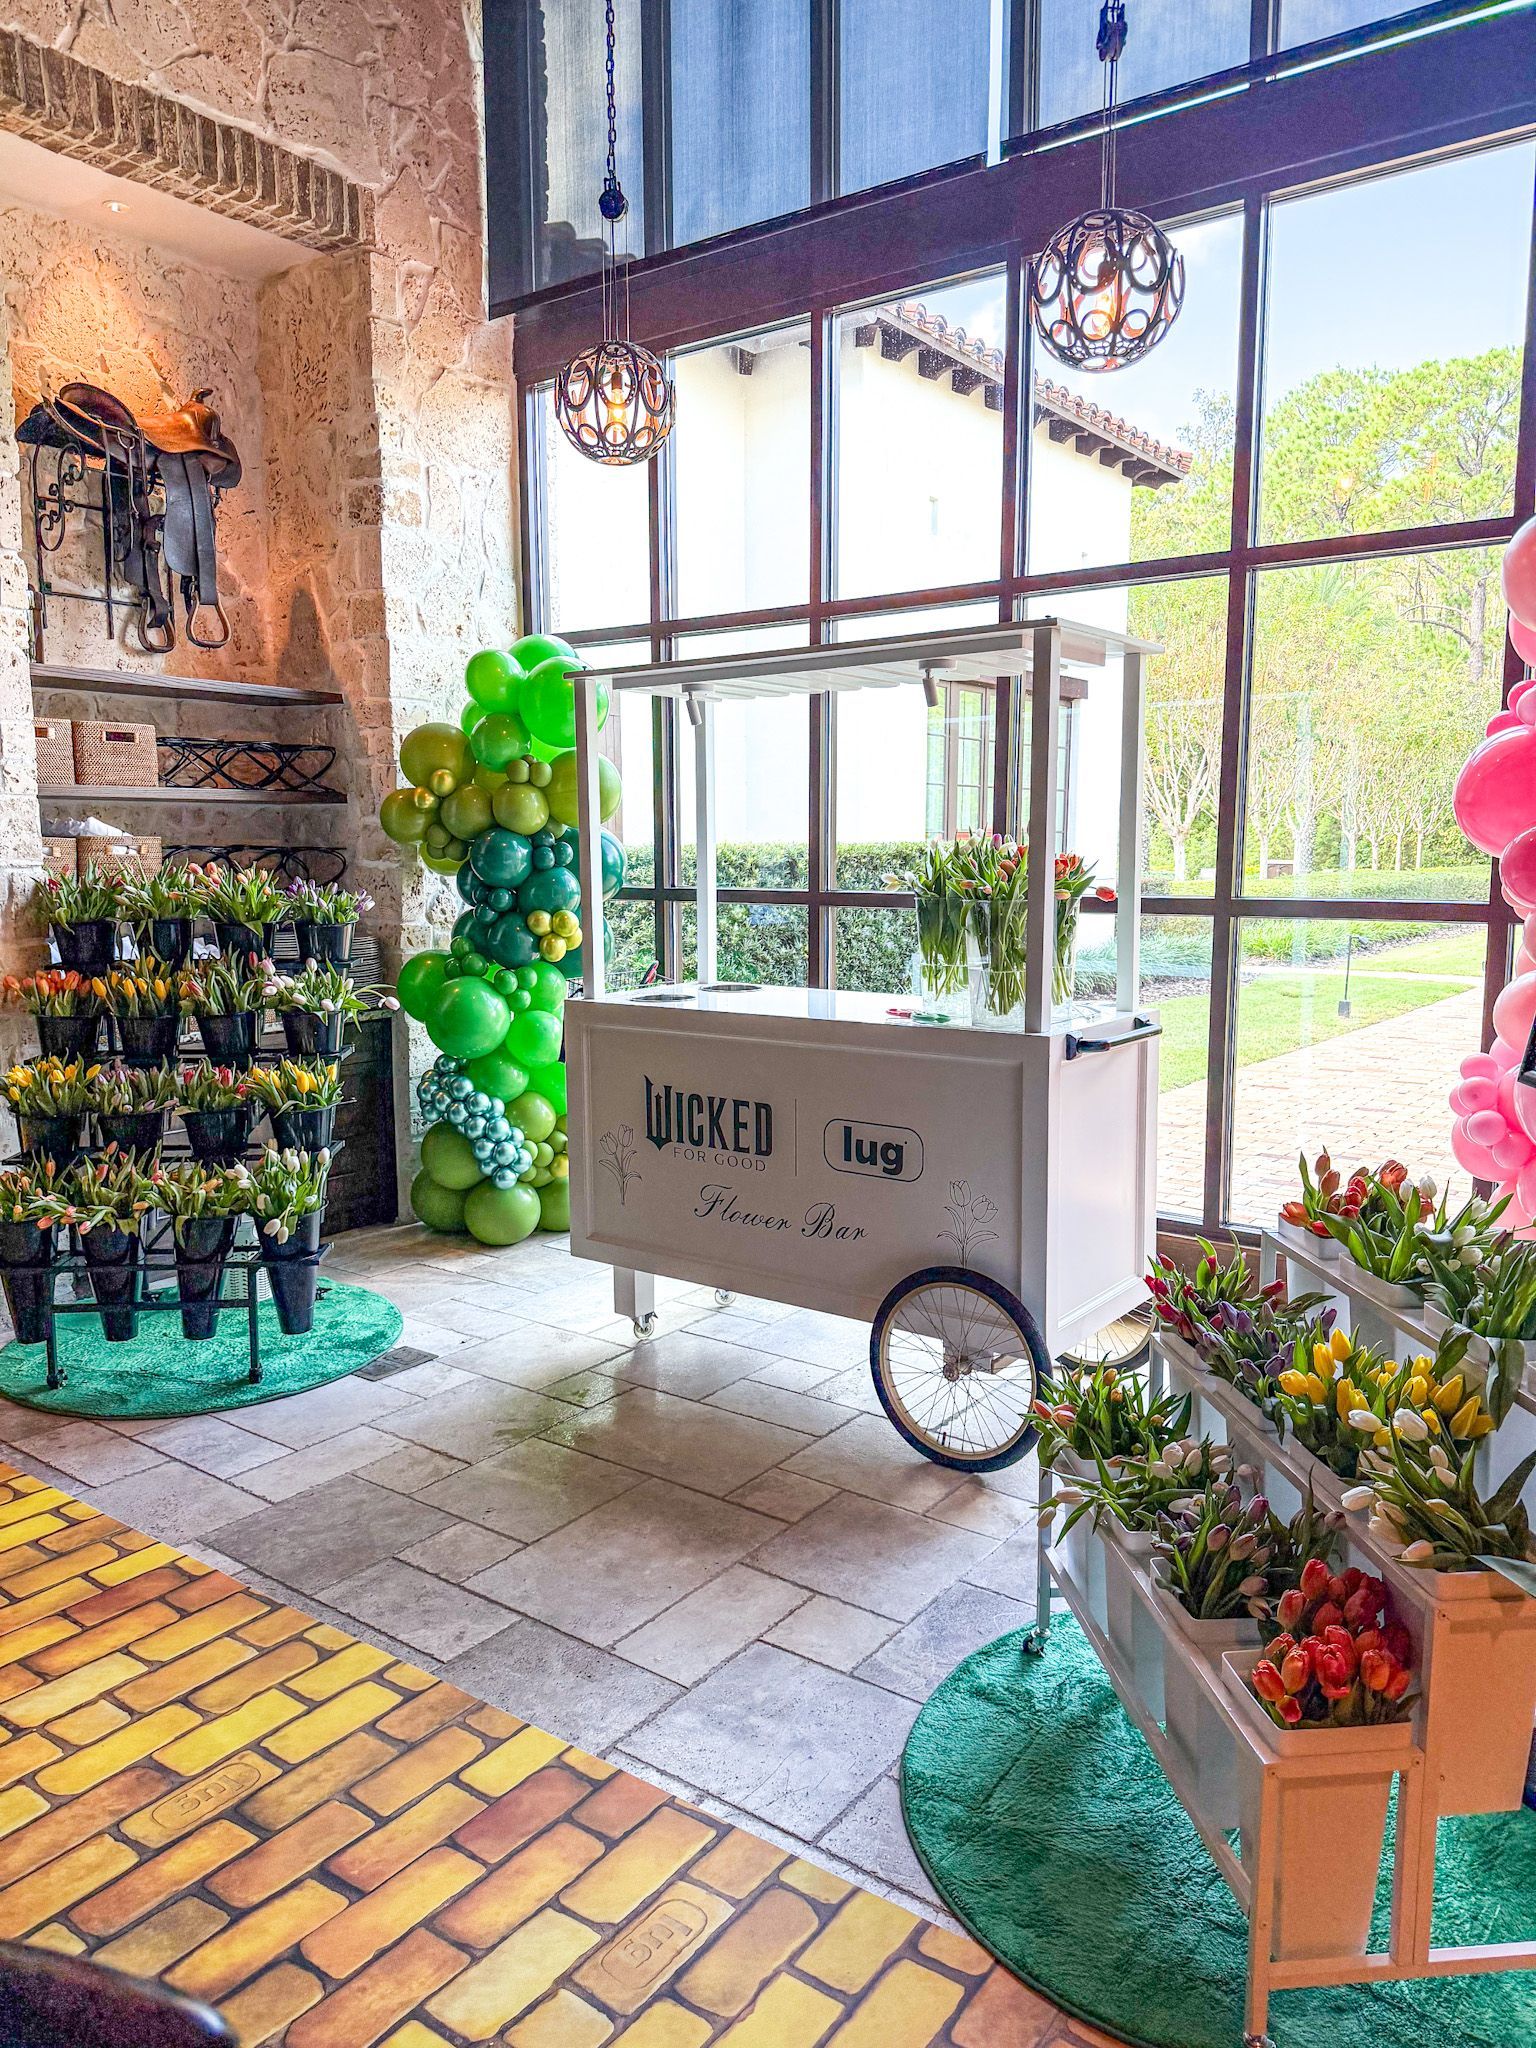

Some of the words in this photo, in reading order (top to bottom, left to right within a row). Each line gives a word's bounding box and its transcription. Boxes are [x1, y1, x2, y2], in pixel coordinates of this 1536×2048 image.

[644, 1075, 773, 1157] WICKED
[673, 1147, 707, 1163] FOR
[714, 1153, 766, 1172] GOOD
[843, 1126, 905, 1176] lug
[693, 1183, 792, 1231] Flower
[801, 1202, 868, 1241] Bar
